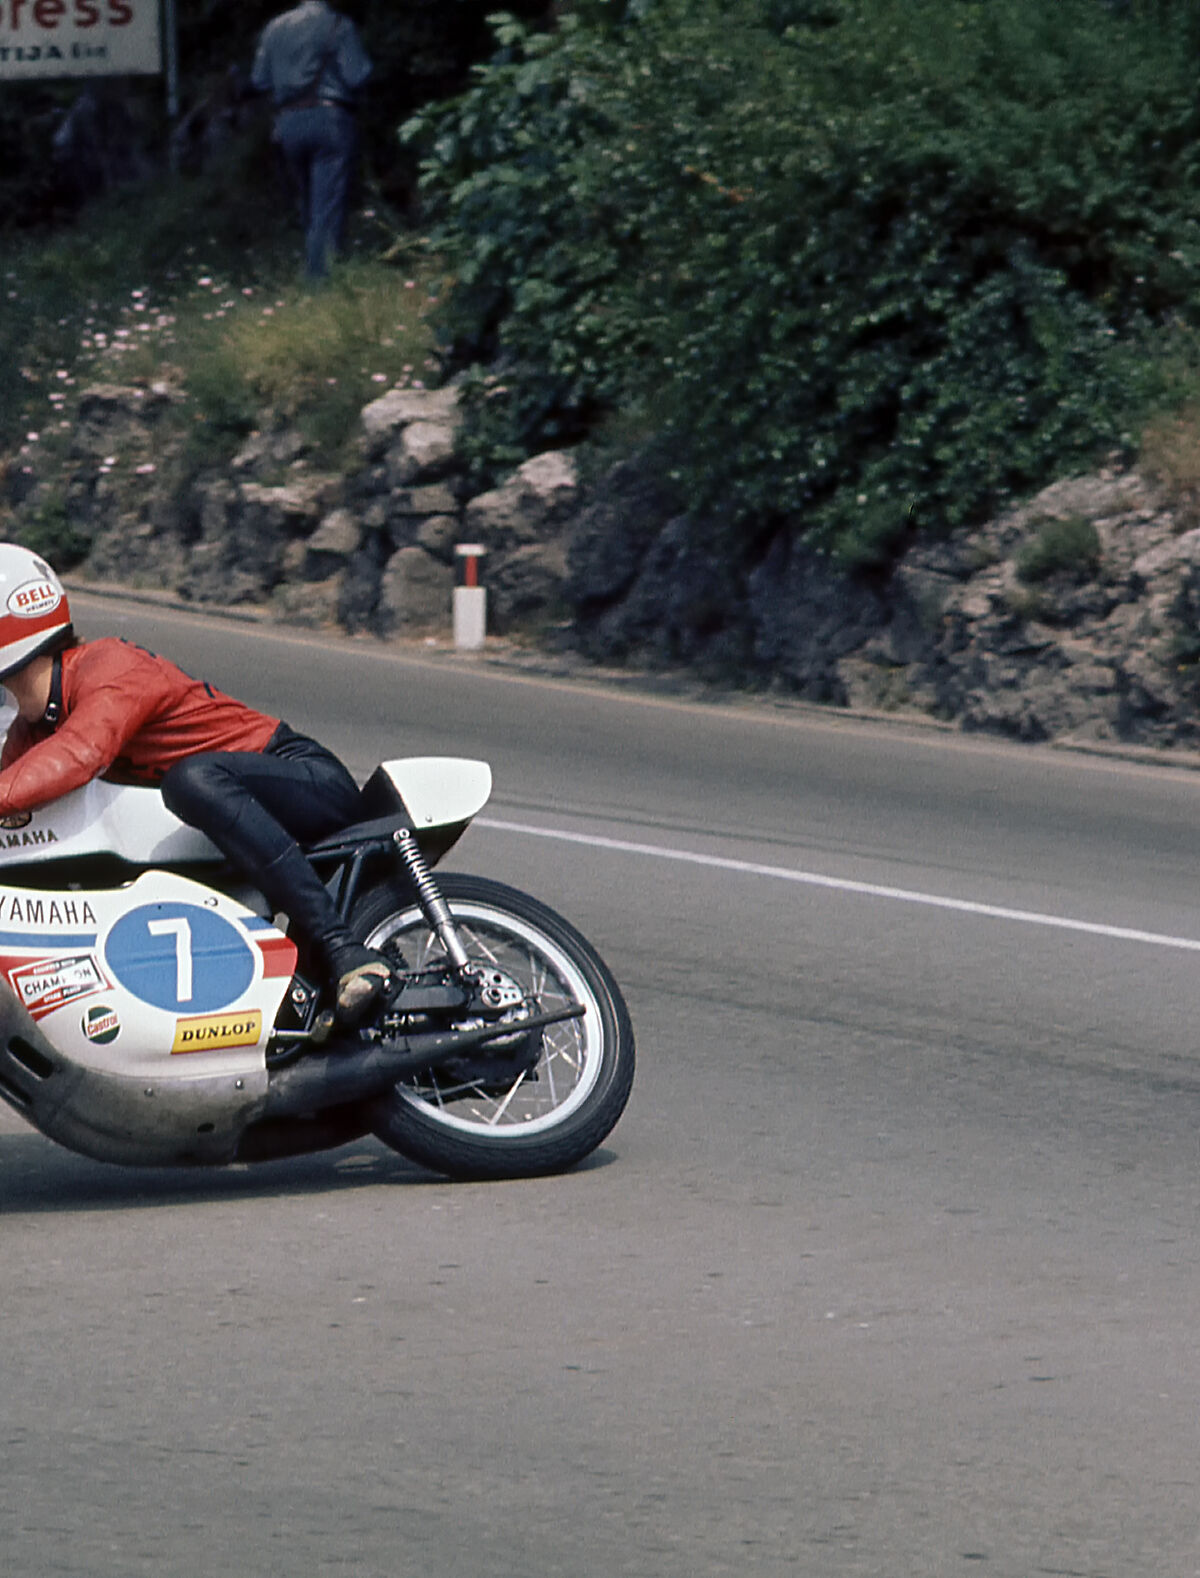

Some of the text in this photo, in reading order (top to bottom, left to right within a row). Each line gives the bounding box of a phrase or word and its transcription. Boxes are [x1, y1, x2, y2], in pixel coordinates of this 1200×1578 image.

[15, 584, 55, 607] BELL
[148, 917, 193, 1003] 7
[87, 1013, 119, 1036] Castrol
[182, 1021, 256, 1042] DUNLOP
